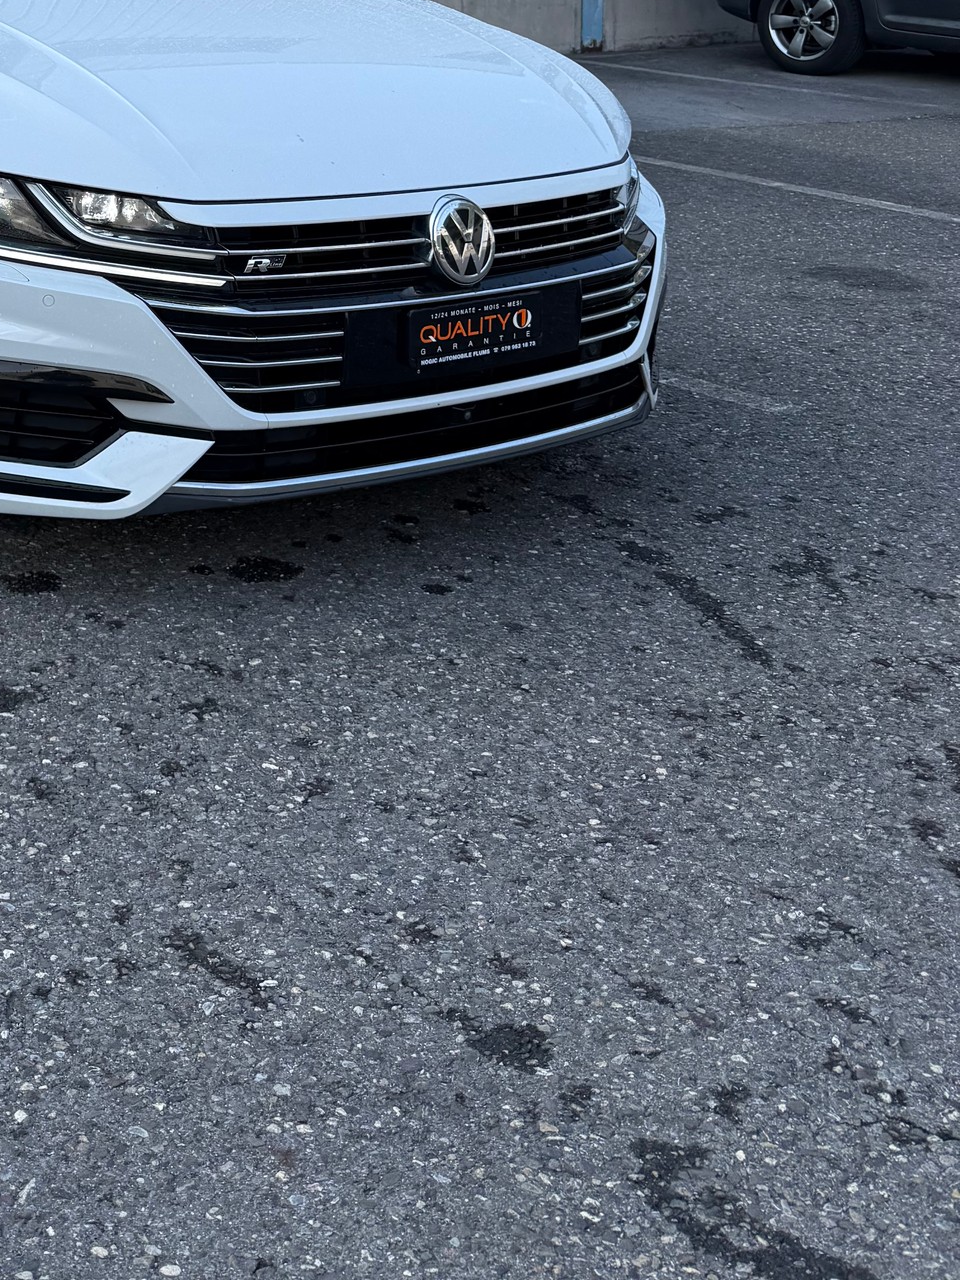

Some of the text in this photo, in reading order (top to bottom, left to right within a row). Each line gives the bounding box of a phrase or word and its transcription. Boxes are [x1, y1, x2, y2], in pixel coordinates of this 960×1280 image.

[450, 307, 476, 316] MONATE
[483, 303, 500, 311] MOIS
[507, 299, 523, 308] MESI
[419, 312, 511, 344] QUALITY
[420, 330, 531, 356] GARANTIE
[438, 352, 473, 363] AUTOMOBILE
[472, 348, 490, 357] FLUMS
